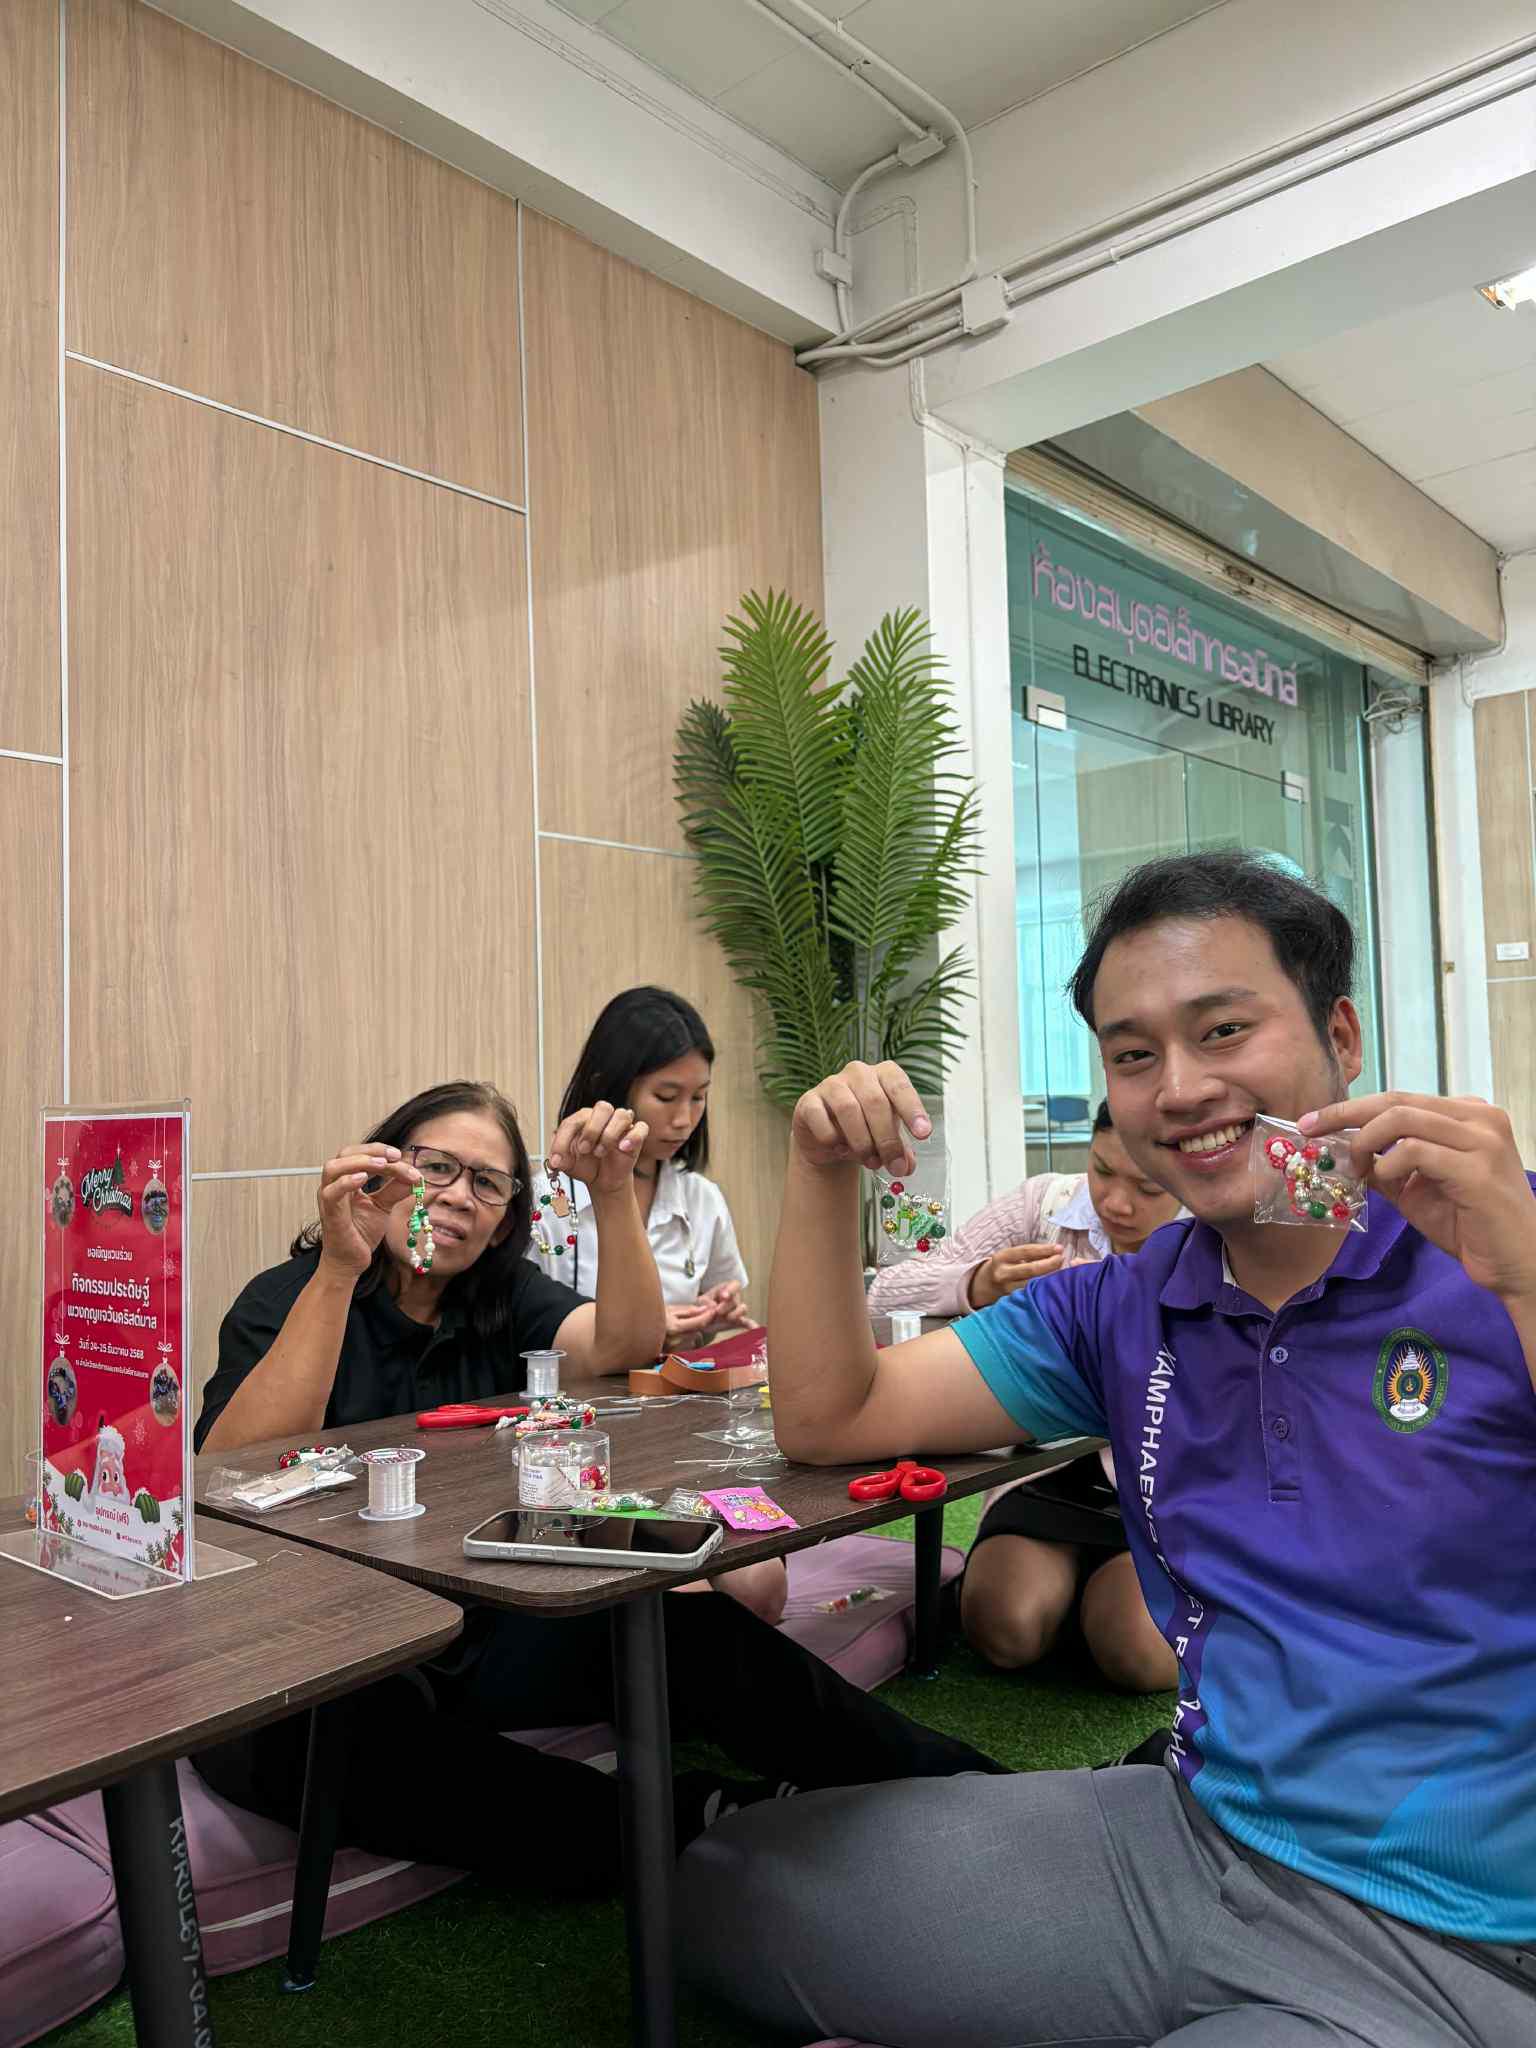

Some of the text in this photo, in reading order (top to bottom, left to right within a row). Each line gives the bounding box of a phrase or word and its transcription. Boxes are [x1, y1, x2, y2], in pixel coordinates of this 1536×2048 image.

[1073, 643, 1275, 746] ELECTRONICS LIBRARY
[72, 1272, 150, 1307] กิจกรรมประดิษฐ์
